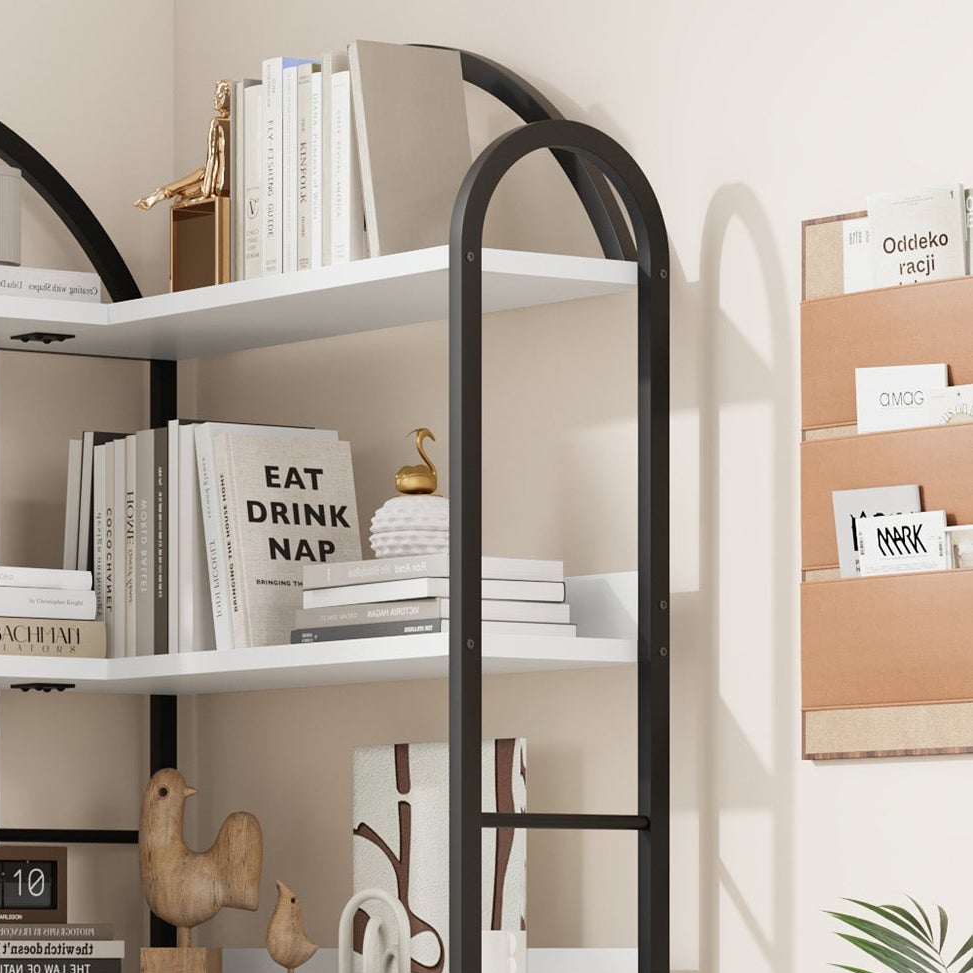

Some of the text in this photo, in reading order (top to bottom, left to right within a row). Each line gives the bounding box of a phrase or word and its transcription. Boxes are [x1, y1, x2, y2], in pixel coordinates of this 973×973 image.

[267, 204, 275, 238] GUIDE
[883, 232, 949, 254] Oddeko
[899, 254, 935, 276] racji
[219, 472, 227, 502] HOME
[264, 465, 324, 490] EAT
[246, 500, 351, 528] DRINK
[268, 537, 336, 562] NAP
[876, 524, 927, 556] MARK
[229, 563, 238, 612] BRINGING
[13, 868, 45, 897] 10
